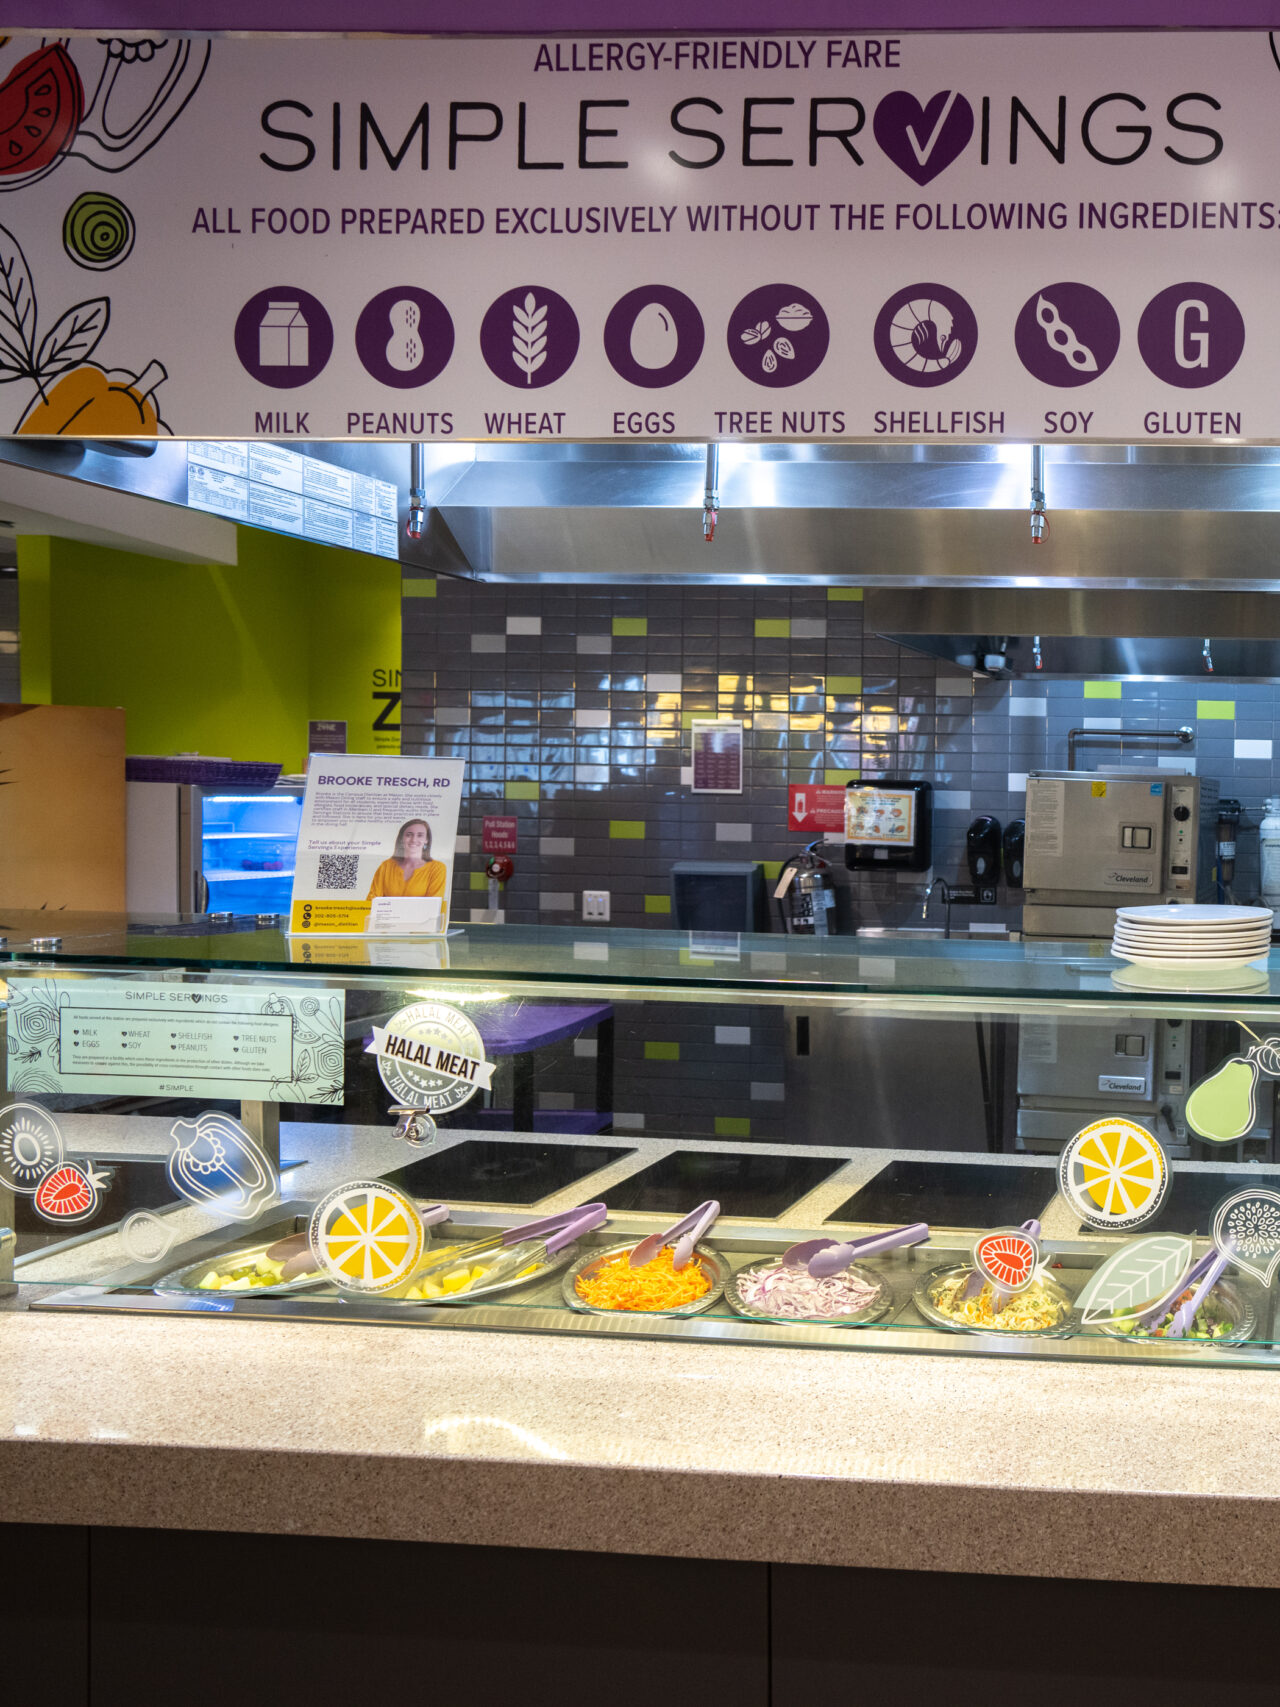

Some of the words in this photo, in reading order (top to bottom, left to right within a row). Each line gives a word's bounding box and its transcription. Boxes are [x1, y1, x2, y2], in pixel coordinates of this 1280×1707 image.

[533, 40, 817, 71] ALLERGY-FRIENDLY
[827, 39, 901, 68] FARE
[260, 99, 629, 172] SIMPLE
[668, 90, 1224, 171] SERVINGS
[192, 208, 241, 234] ALL
[251, 207, 330, 234] FOOD
[342, 207, 485, 234] PREPARED
[495, 206, 677, 233] EXCLUSIVELY
[686, 205, 821, 232] WITHOUT
[830, 204, 884, 231] THE
[896, 203, 1067, 230] FOLLOWING
[1174, 299, 1209, 368] G
[255, 412, 310, 433] MILK
[347, 412, 454, 434] PEANUTS
[484, 412, 566, 434] WHEAT
[613, 412, 675, 434] EGGS
[714, 411, 772, 433] TREE
[782, 411, 845, 434] NUTS
[874, 411, 1005, 433] SHELLFISH
[1044, 411, 1094, 433] SOY
[1144, 411, 1241, 434] GLUTEN
[318, 775, 372, 786] BROOKE
[376, 777, 429, 788] TRESCH,
[433, 778, 450, 787] RD
[1115, 874, 1149, 884] Cleveland
[125, 991, 166, 1001] SIMPLE
[169, 992, 228, 1004] SERVINGS
[82, 1029, 98, 1037] MILK
[178, 1032, 212, 1040] SHELLFISH
[259, 1035, 277, 1043] NUTS
[178, 1044, 208, 1052] PEANUTS
[241, 1046, 267, 1054] GLUTEN
[385, 1034, 432, 1067] HALAL
[435, 1051, 480, 1080] MEAT
[159, 1084, 194, 1092] #SIMPLE
[389, 1076, 419, 1106] HALAL
[424, 1092, 453, 1108] MEAT
[1108, 1082, 1142, 1091] Cleveland
